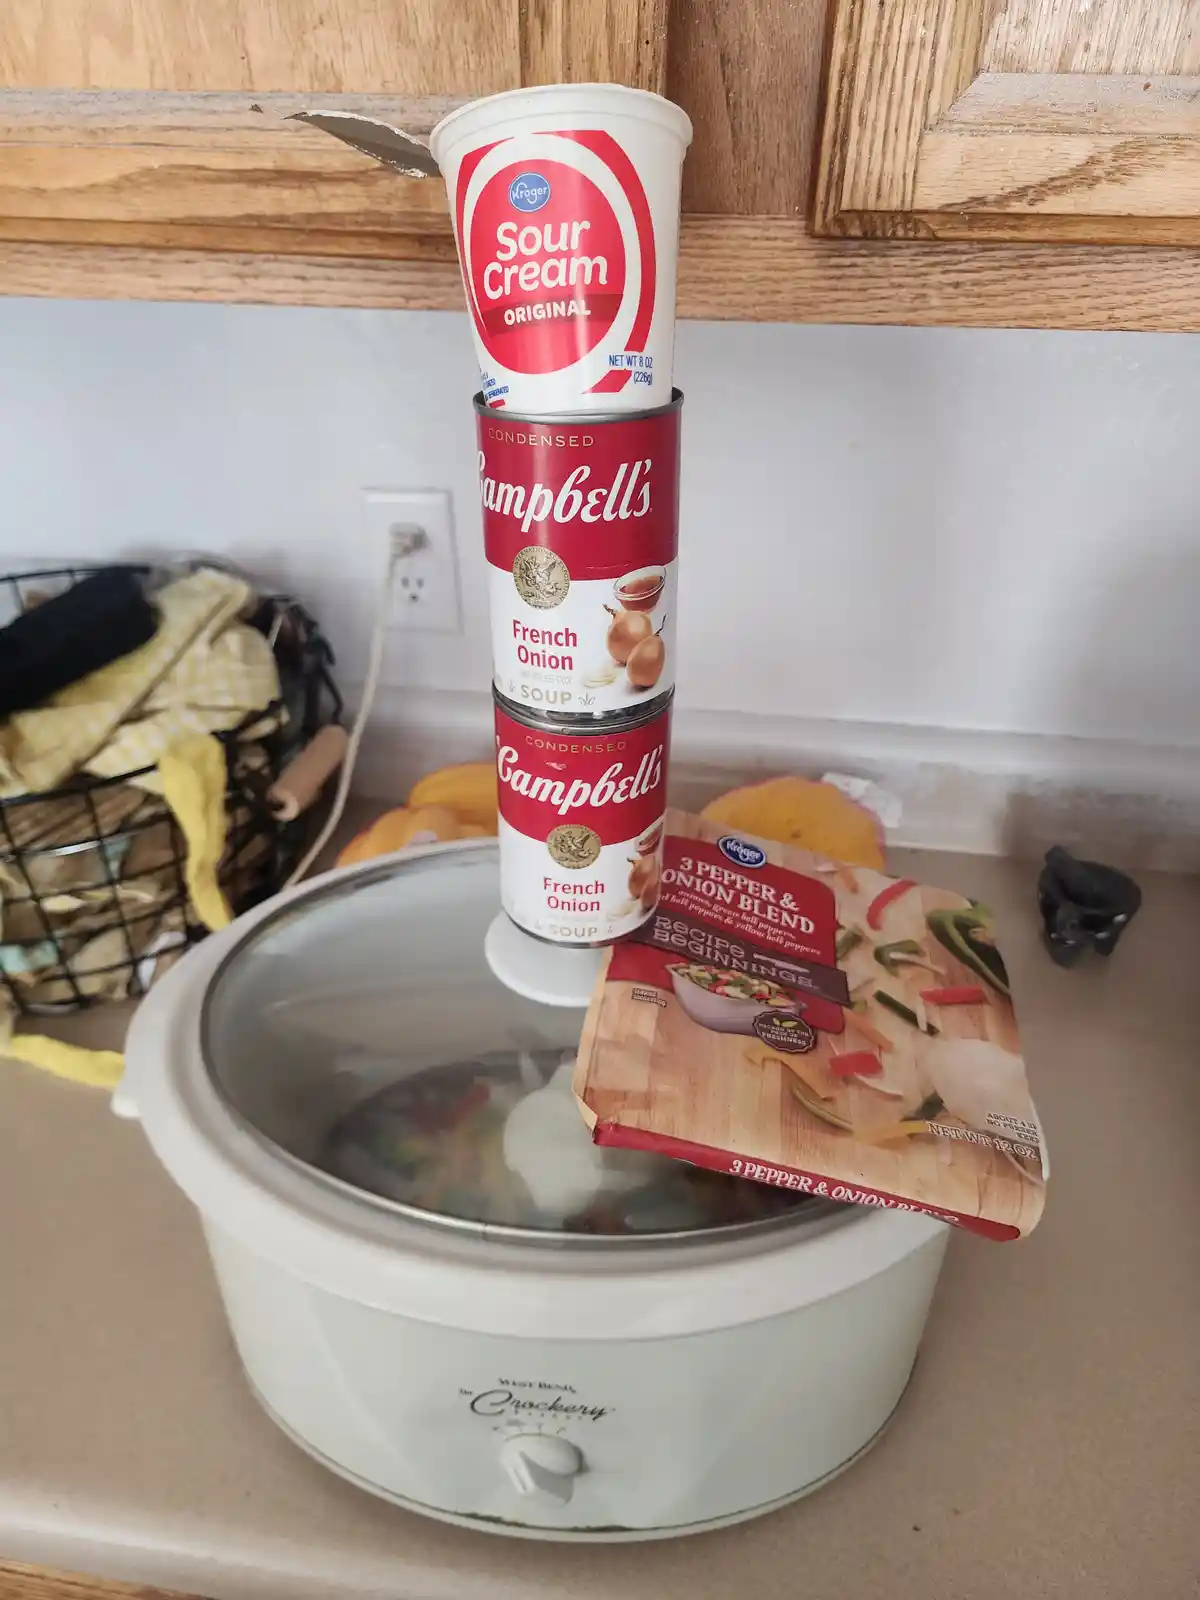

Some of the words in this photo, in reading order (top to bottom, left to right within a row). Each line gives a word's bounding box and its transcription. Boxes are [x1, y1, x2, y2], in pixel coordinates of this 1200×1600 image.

[511, 181, 548, 204] Kroger
[496, 220, 591, 261] Sour
[483, 255, 608, 300] Cream
[503, 299, 591, 326] ORIGINAL
[609, 354, 624, 367] NET
[626, 355, 637, 367] WT
[639, 356, 644, 368] 8
[645, 356, 653, 369] OZ
[634, 371, 653, 386] (226g)
[488, 428, 595, 448] CONDENSED
[513, 618, 577, 648] French
[517, 644, 574, 671] Onion
[520, 684, 573, 705] SOUP
[525, 736, 626, 754] CONDENSED
[497, 744, 664, 816] Campbell's
[725, 838, 762, 863] Kroger
[543, 876, 605, 895] French
[680, 856, 693, 872] 3
[696, 861, 776, 901] PEPPER
[779, 891, 800, 912] &
[547, 895, 601, 912] Onion
[661, 868, 738, 905] ONION
[737, 894, 815, 935] BLEND
[670, 895, 690, 908] bell
[724, 916, 734, 926] &
[549, 924, 598, 938] SOUP
[740, 911, 759, 926] bell
[929, 1121, 962, 1140] NET
[963, 1130, 992, 1148] WT
[729, 1159, 742, 1174] 3
[743, 1161, 813, 1192] PEPPER
[813, 1181, 829, 1196] &
[831, 1185, 896, 1209] ONION
[469, 1387, 608, 1422] Crockery
